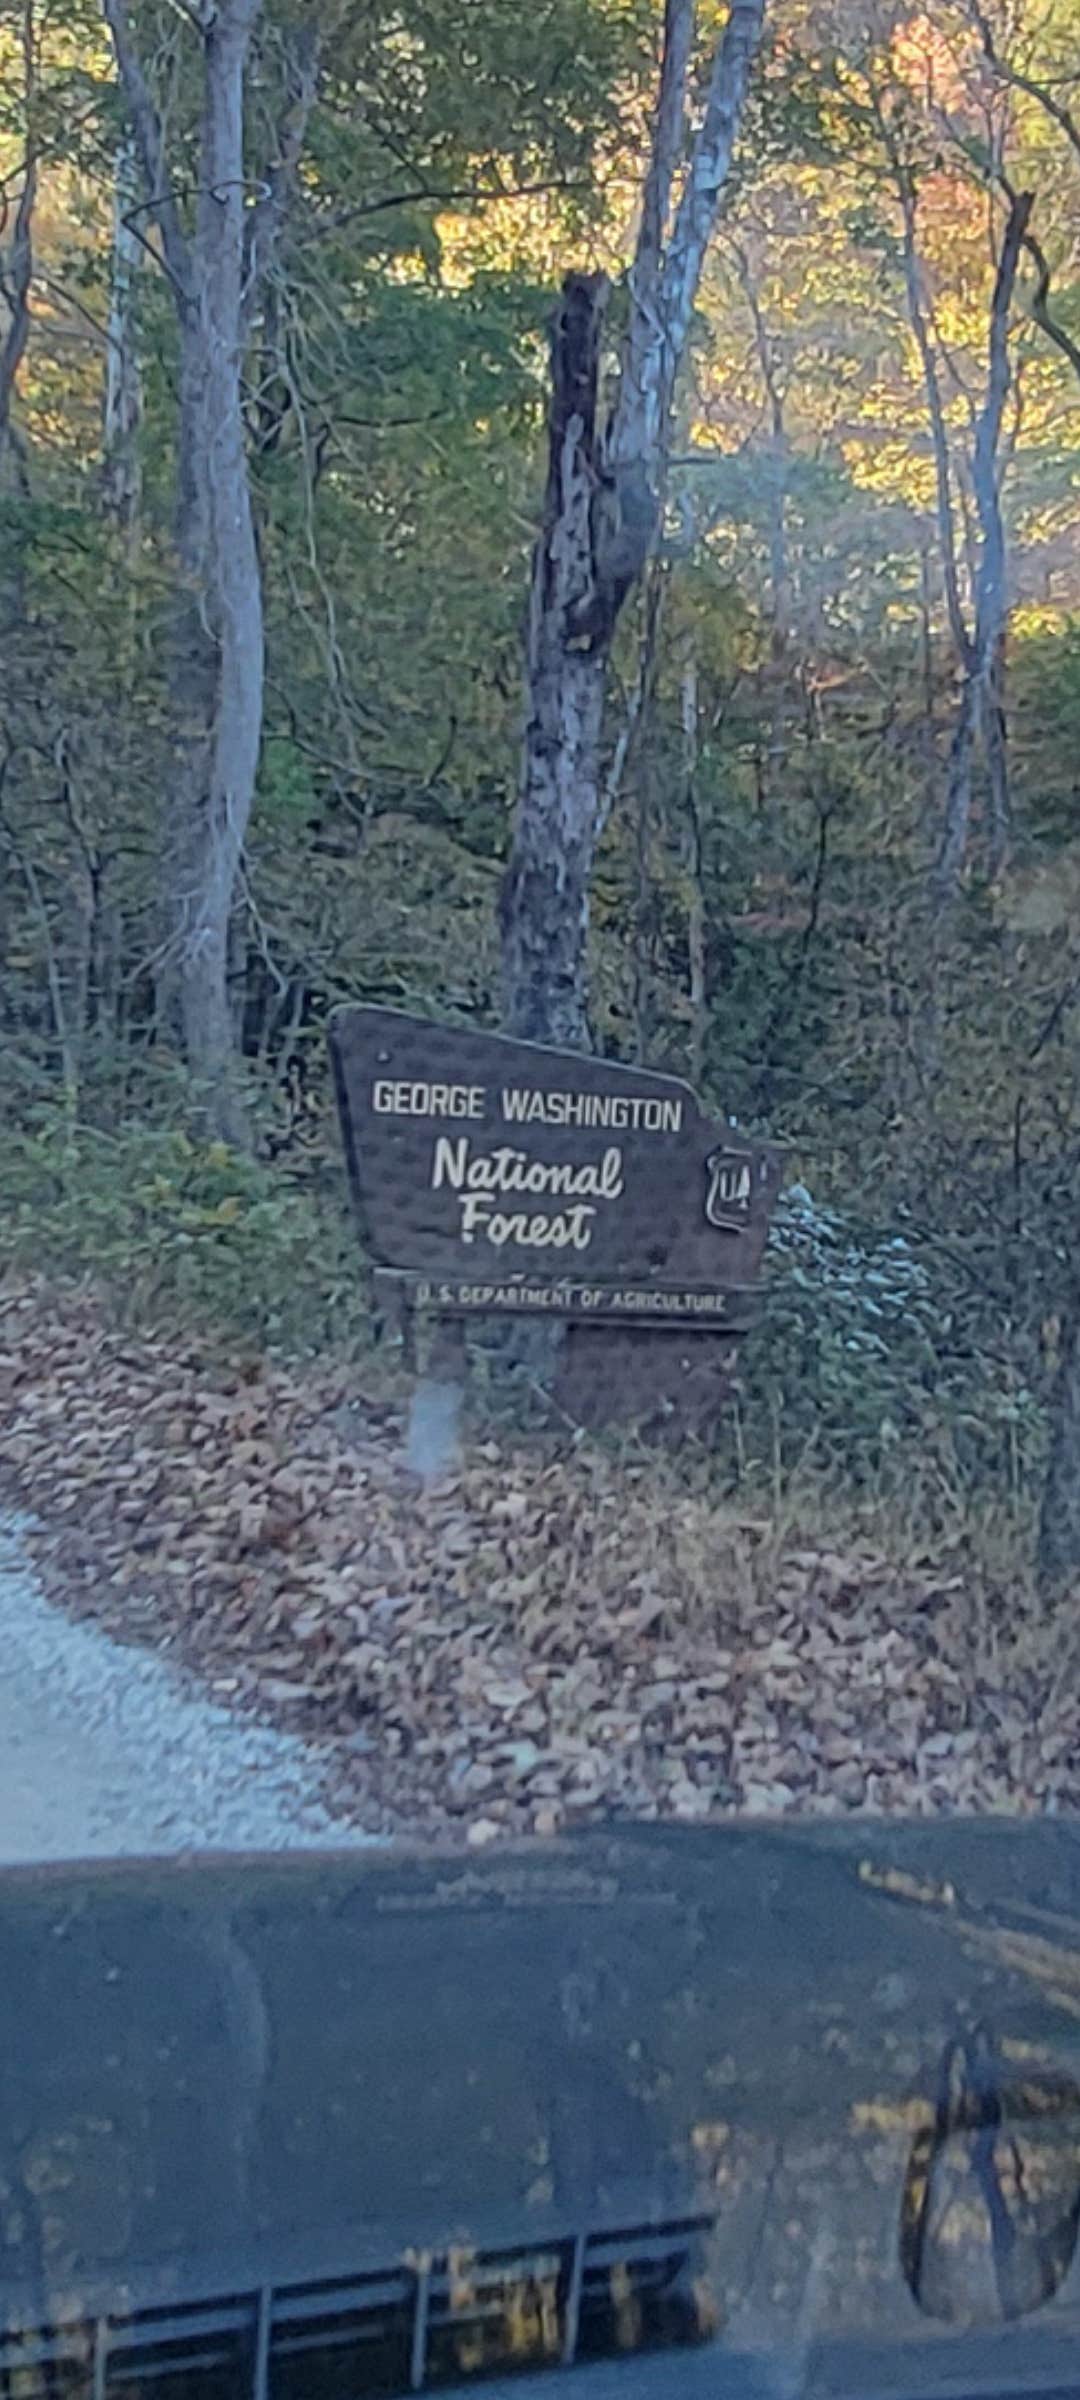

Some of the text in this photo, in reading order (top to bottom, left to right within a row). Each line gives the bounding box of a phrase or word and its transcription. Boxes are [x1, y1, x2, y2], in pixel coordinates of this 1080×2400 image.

[373, 1080, 682, 1132] GEORGE WASHINGTON
[432, 1137, 624, 1199] National
[458, 1191, 597, 1250] Forest
[459, 1285, 571, 1308] DEPARTMENT
[580, 1289, 602, 1307] OF
[610, 1290, 725, 1312] AGRICULTURE
